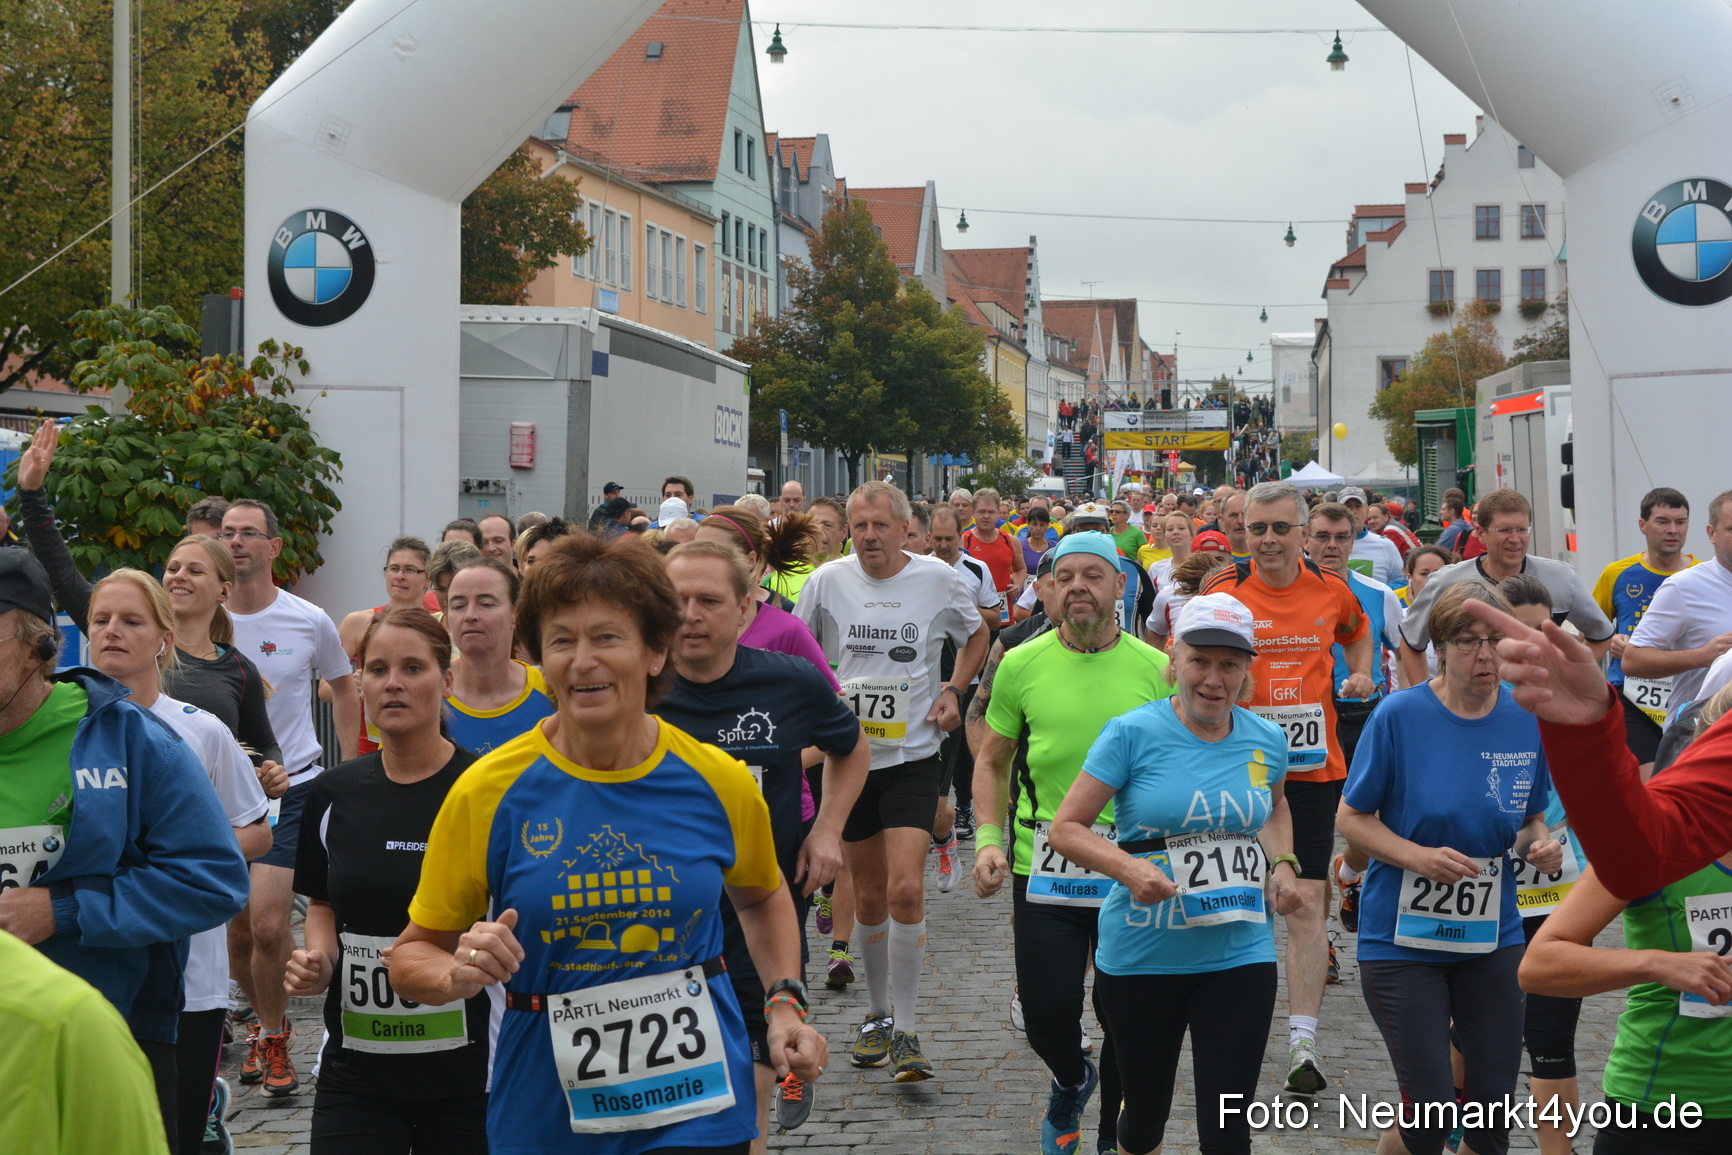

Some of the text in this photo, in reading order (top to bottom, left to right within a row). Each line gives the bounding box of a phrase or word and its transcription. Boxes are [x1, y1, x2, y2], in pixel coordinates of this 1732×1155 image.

[275, 211, 367, 251] BMW
[714, 405, 743, 448] BOCK
[1145, 435, 1188, 446] START
[848, 625, 897, 640] Allianz
[1253, 635, 1320, 647] SportScheck
[861, 683, 898, 691] Neumarkt
[1273, 687, 1298, 701] GfK
[849, 693, 896, 720] 173
[1277, 711, 1313, 719] Neumarkt
[717, 729, 756, 744] Spitz
[862, 724, 886, 738] eorg
[1481, 752, 1537, 760] 12. NEUMARKTER
[1492, 759, 1531, 767] STADTLAUF
[75, 767, 128, 789] NA
[537, 823, 548, 832] 15
[530, 833, 555, 843] Jahre
[1169, 836, 1206, 850] PARTL
[1184, 845, 1260, 888] 2142
[1050, 881, 1098, 895] Andreas
[1201, 891, 1256, 911] Hannelore
[1411, 876, 1494, 916] 2267
[1517, 890, 1560, 906] Claudia
[641, 908, 671, 918] 2014
[1690, 906, 1732, 922] PART
[1435, 924, 1466, 939] Anni
[342, 944, 374, 959] PARTL
[350, 963, 421, 1009] 50
[553, 987, 682, 1023] PARTL Neumarkt
[371, 1019, 425, 1037] Carina
[572, 1006, 706, 1081] 2723
[592, 1077, 704, 1113] Rosemarie
